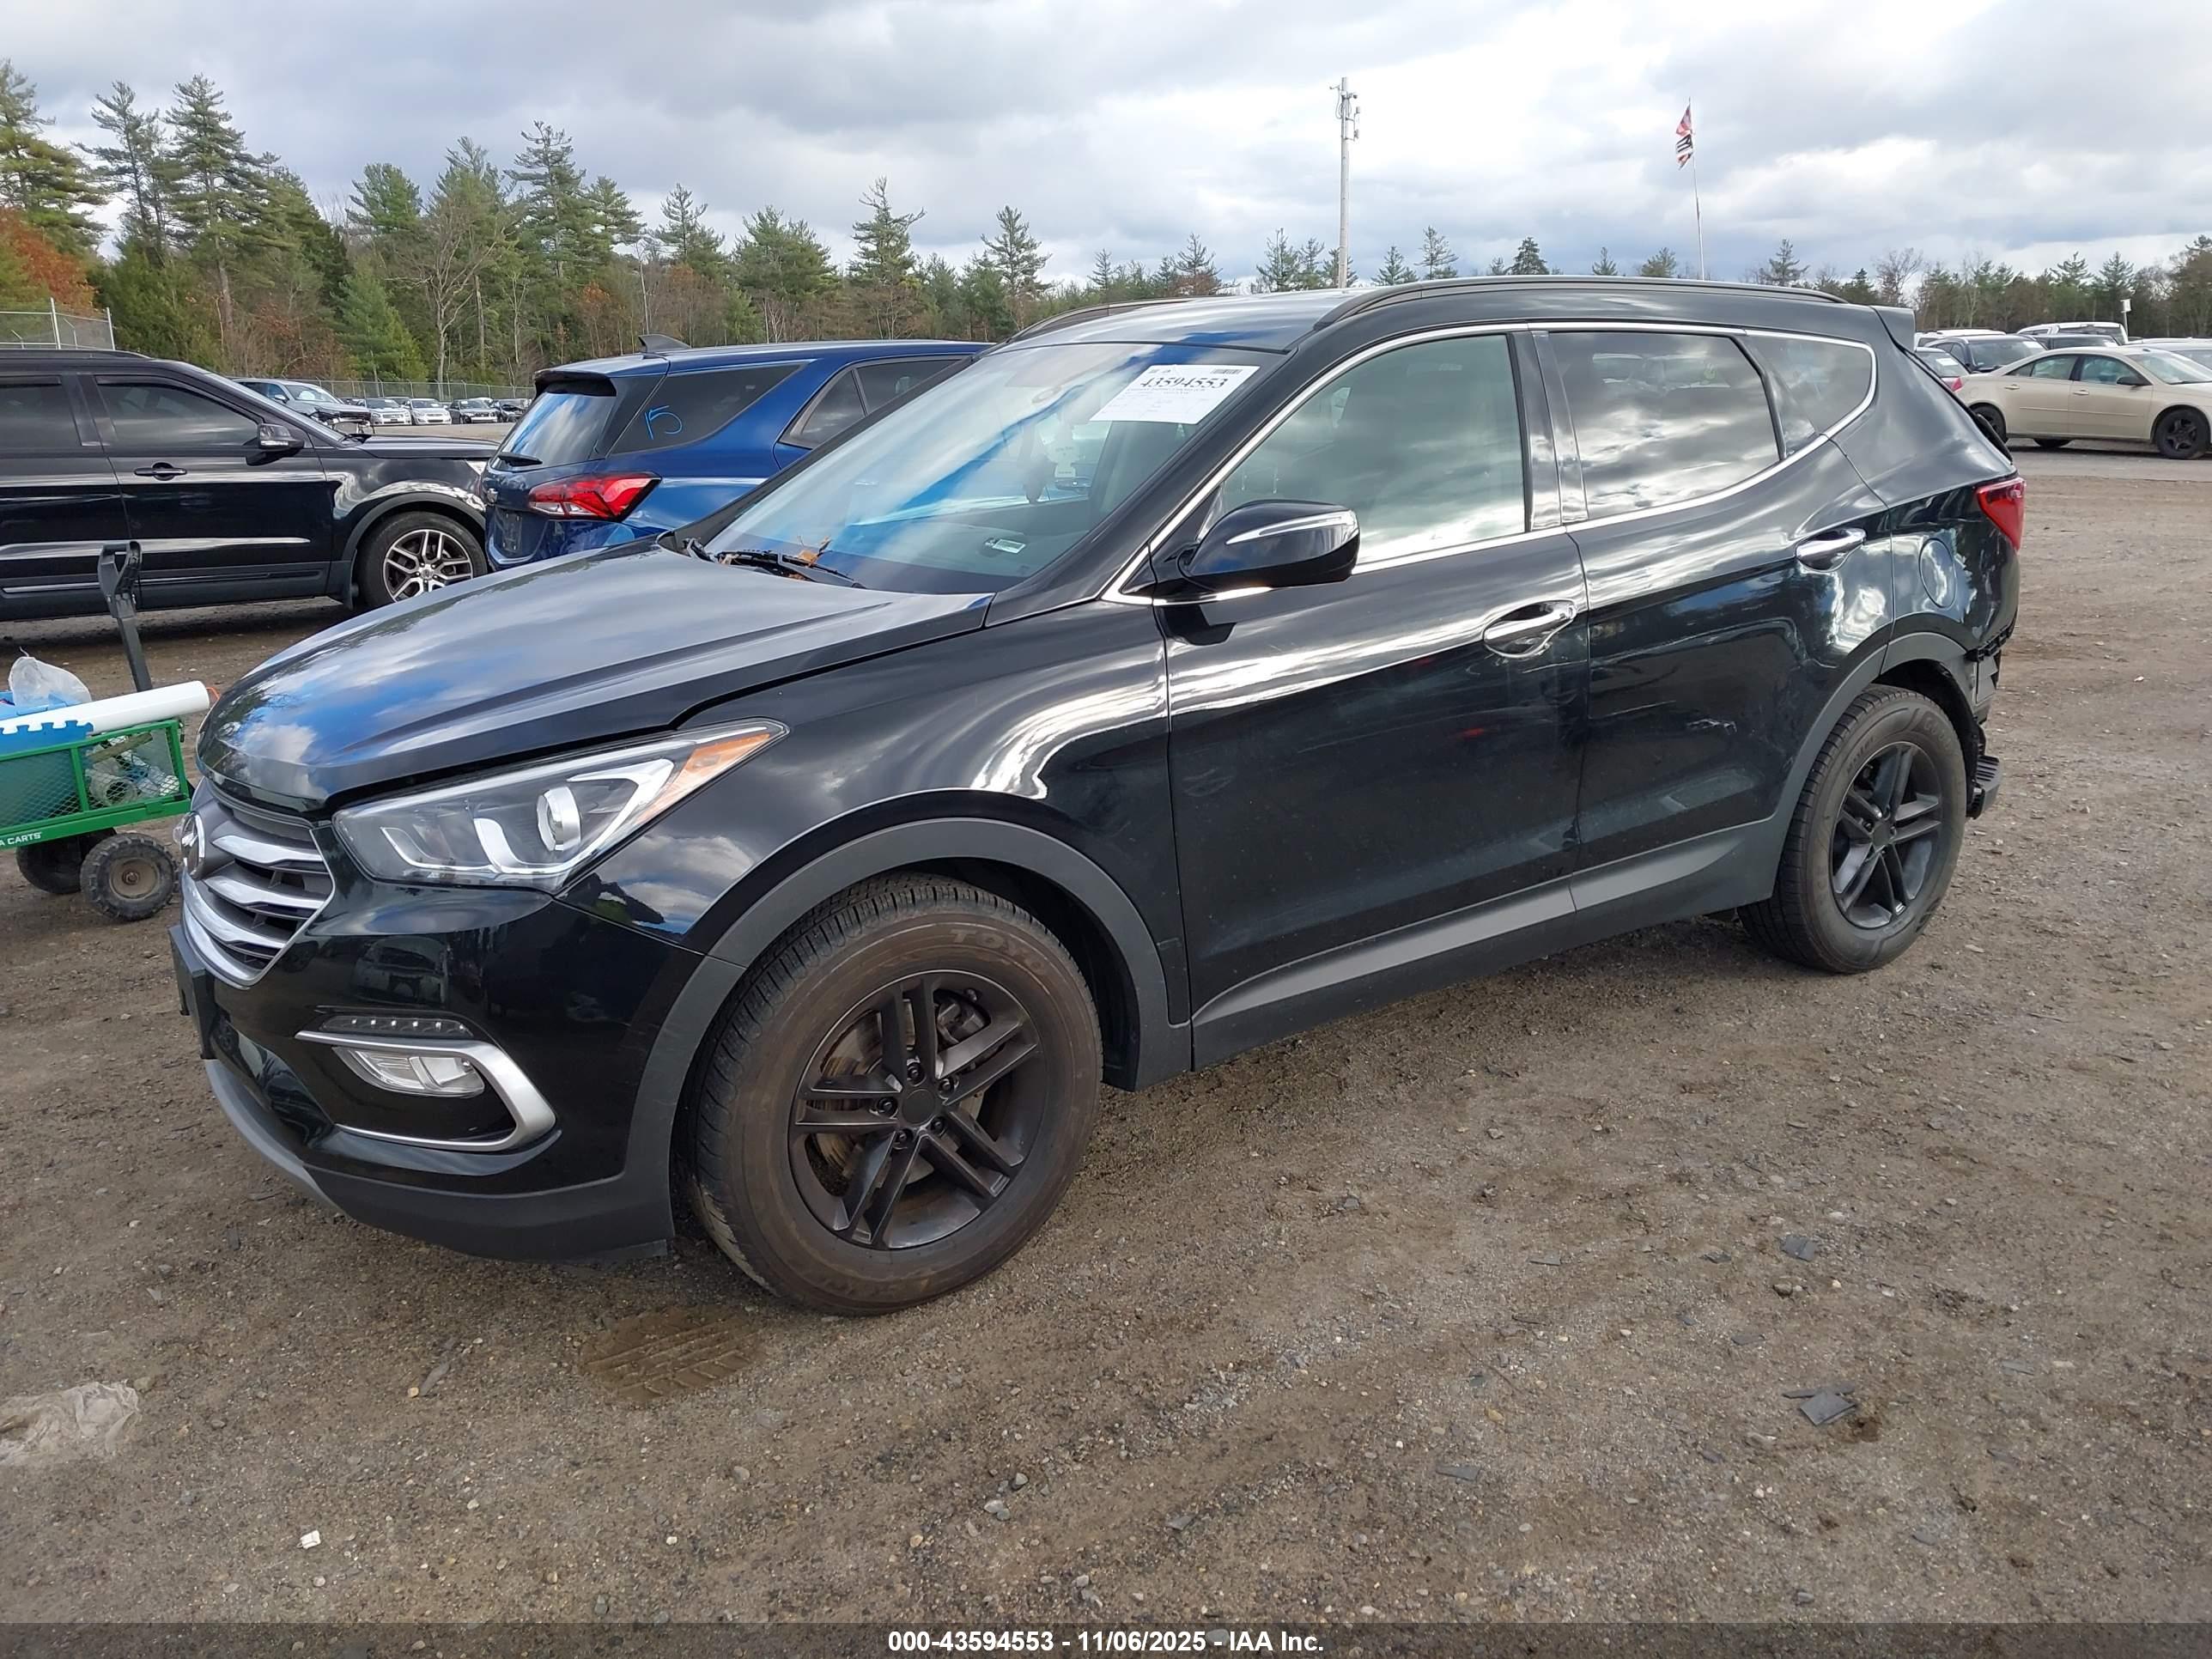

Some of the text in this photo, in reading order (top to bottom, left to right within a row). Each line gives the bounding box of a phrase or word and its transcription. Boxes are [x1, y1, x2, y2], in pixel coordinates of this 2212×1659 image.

[1139, 377, 1229, 389] 43594553
[7, 832, 42, 845] CARTS
[949, 928, 1047, 975] TOYO
